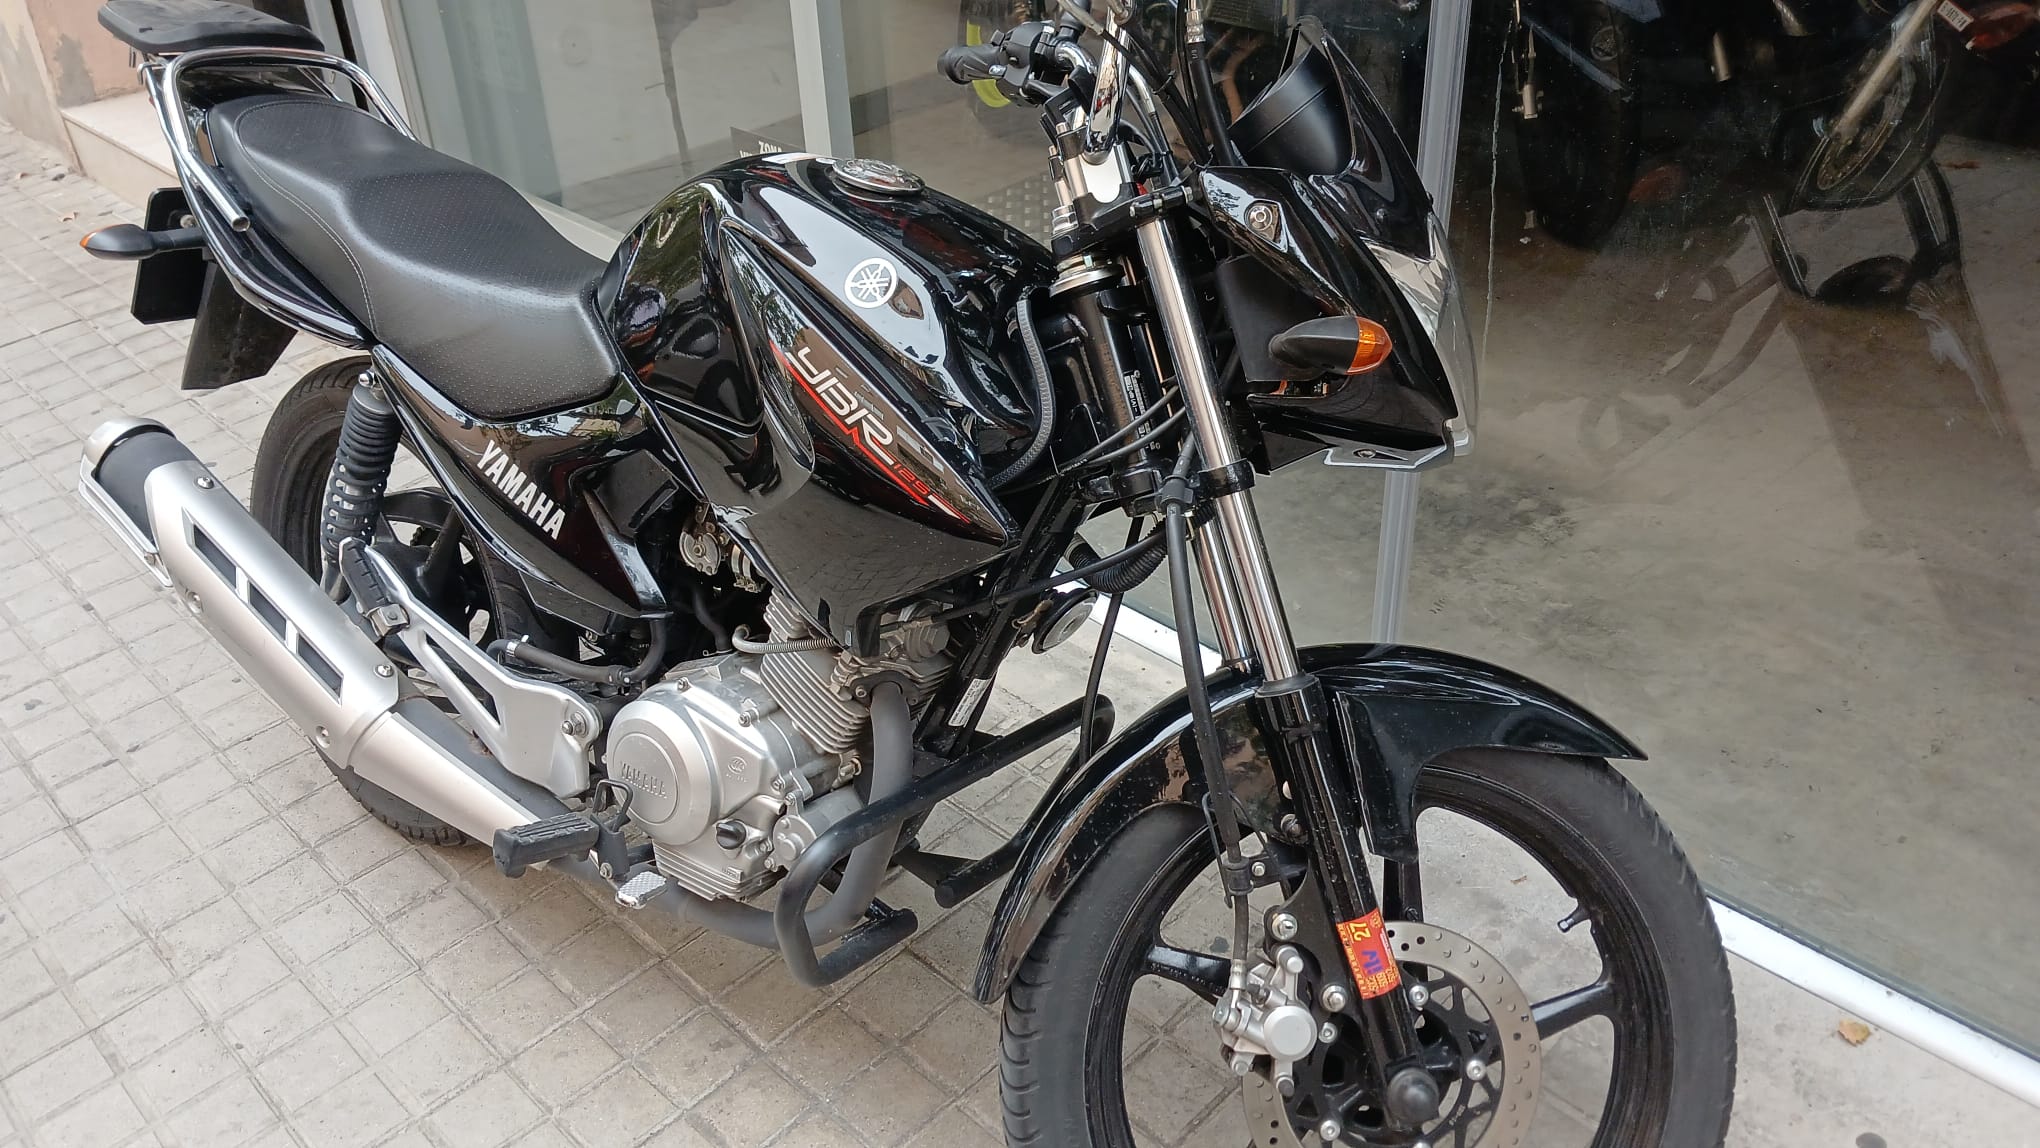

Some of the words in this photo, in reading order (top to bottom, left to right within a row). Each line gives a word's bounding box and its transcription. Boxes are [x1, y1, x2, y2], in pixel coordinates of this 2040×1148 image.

[785, 346, 894, 465] YBR
[893, 464, 931, 495] 125
[477, 439, 566, 540] YAMAHA
[1349, 922, 1371, 941] 27
